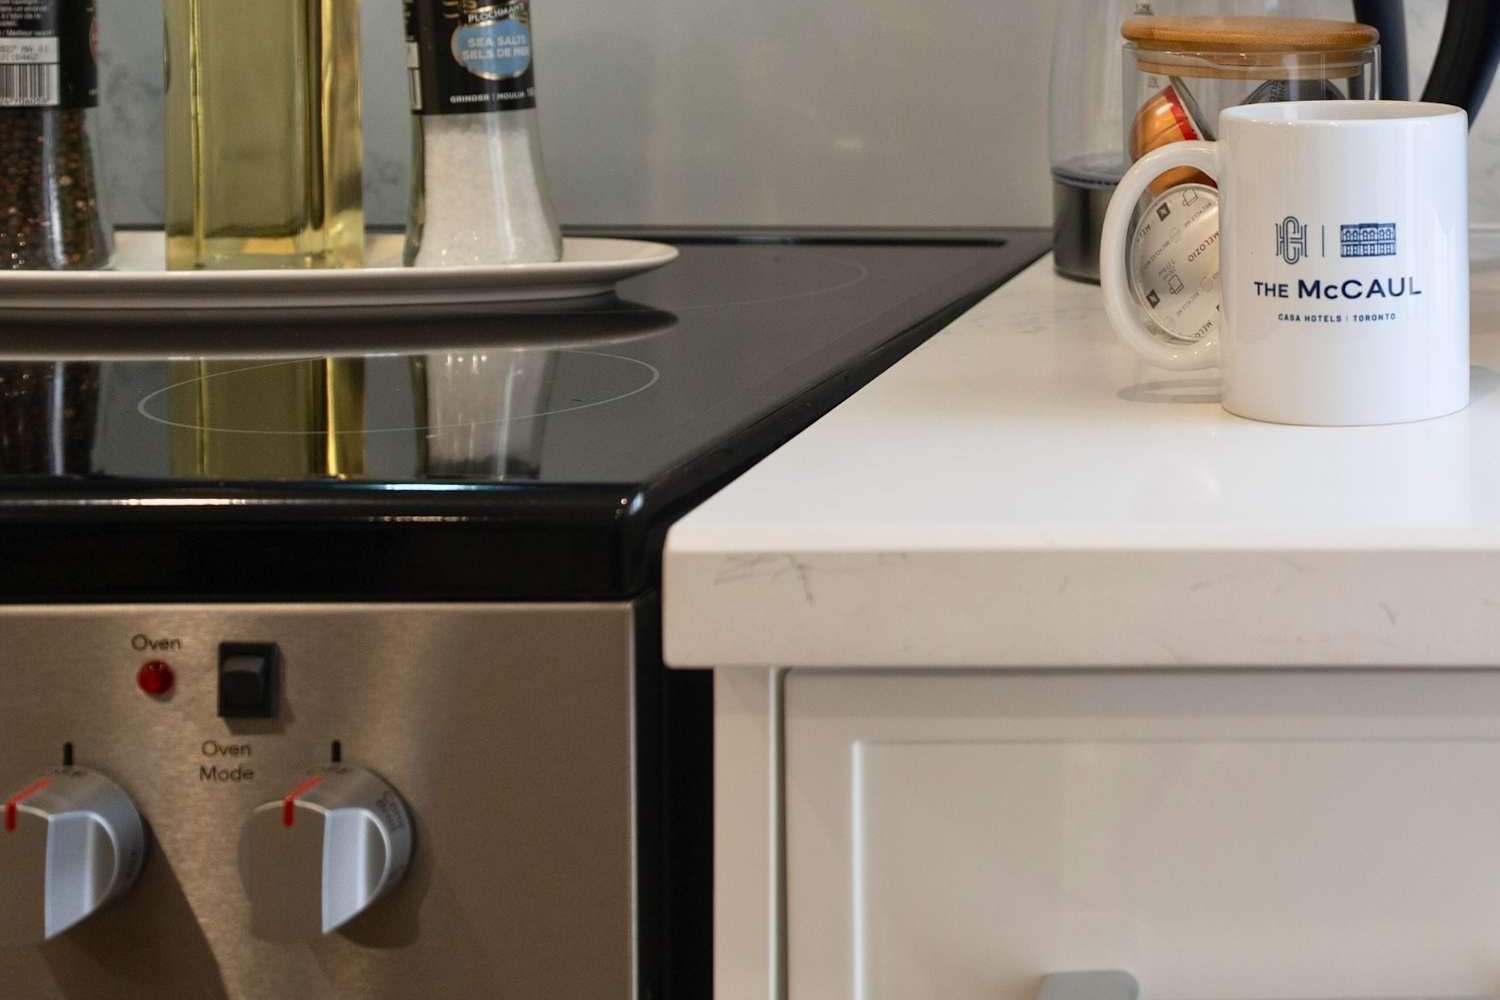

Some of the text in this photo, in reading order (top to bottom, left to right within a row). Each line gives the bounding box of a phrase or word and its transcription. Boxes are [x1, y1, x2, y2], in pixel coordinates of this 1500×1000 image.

[1253, 277, 1422, 300] THE McCAUL
[1278, 313, 1396, 323] CASA HOTELS TORONTO
[131, 633, 181, 652] Oven
[201, 741, 252, 759] Oven
[200, 765, 254, 783] Mode
